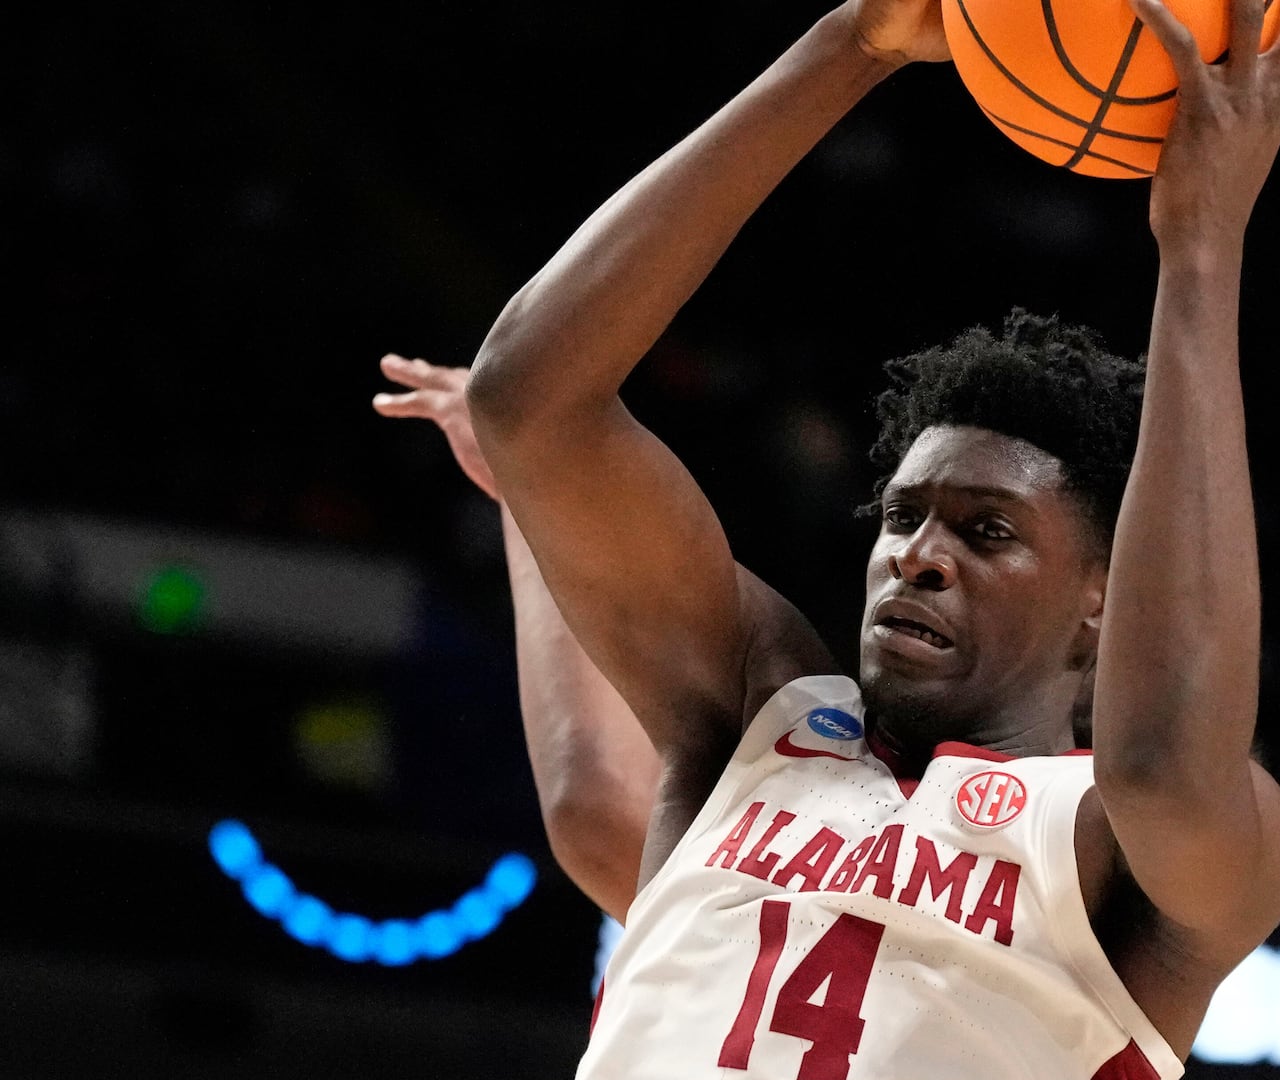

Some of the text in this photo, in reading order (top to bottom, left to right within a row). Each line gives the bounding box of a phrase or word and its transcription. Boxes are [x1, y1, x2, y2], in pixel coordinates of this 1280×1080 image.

[812, 713, 855, 738] NCAA
[961, 774, 1024, 824] SEC
[704, 801, 1022, 947] ALABAMA
